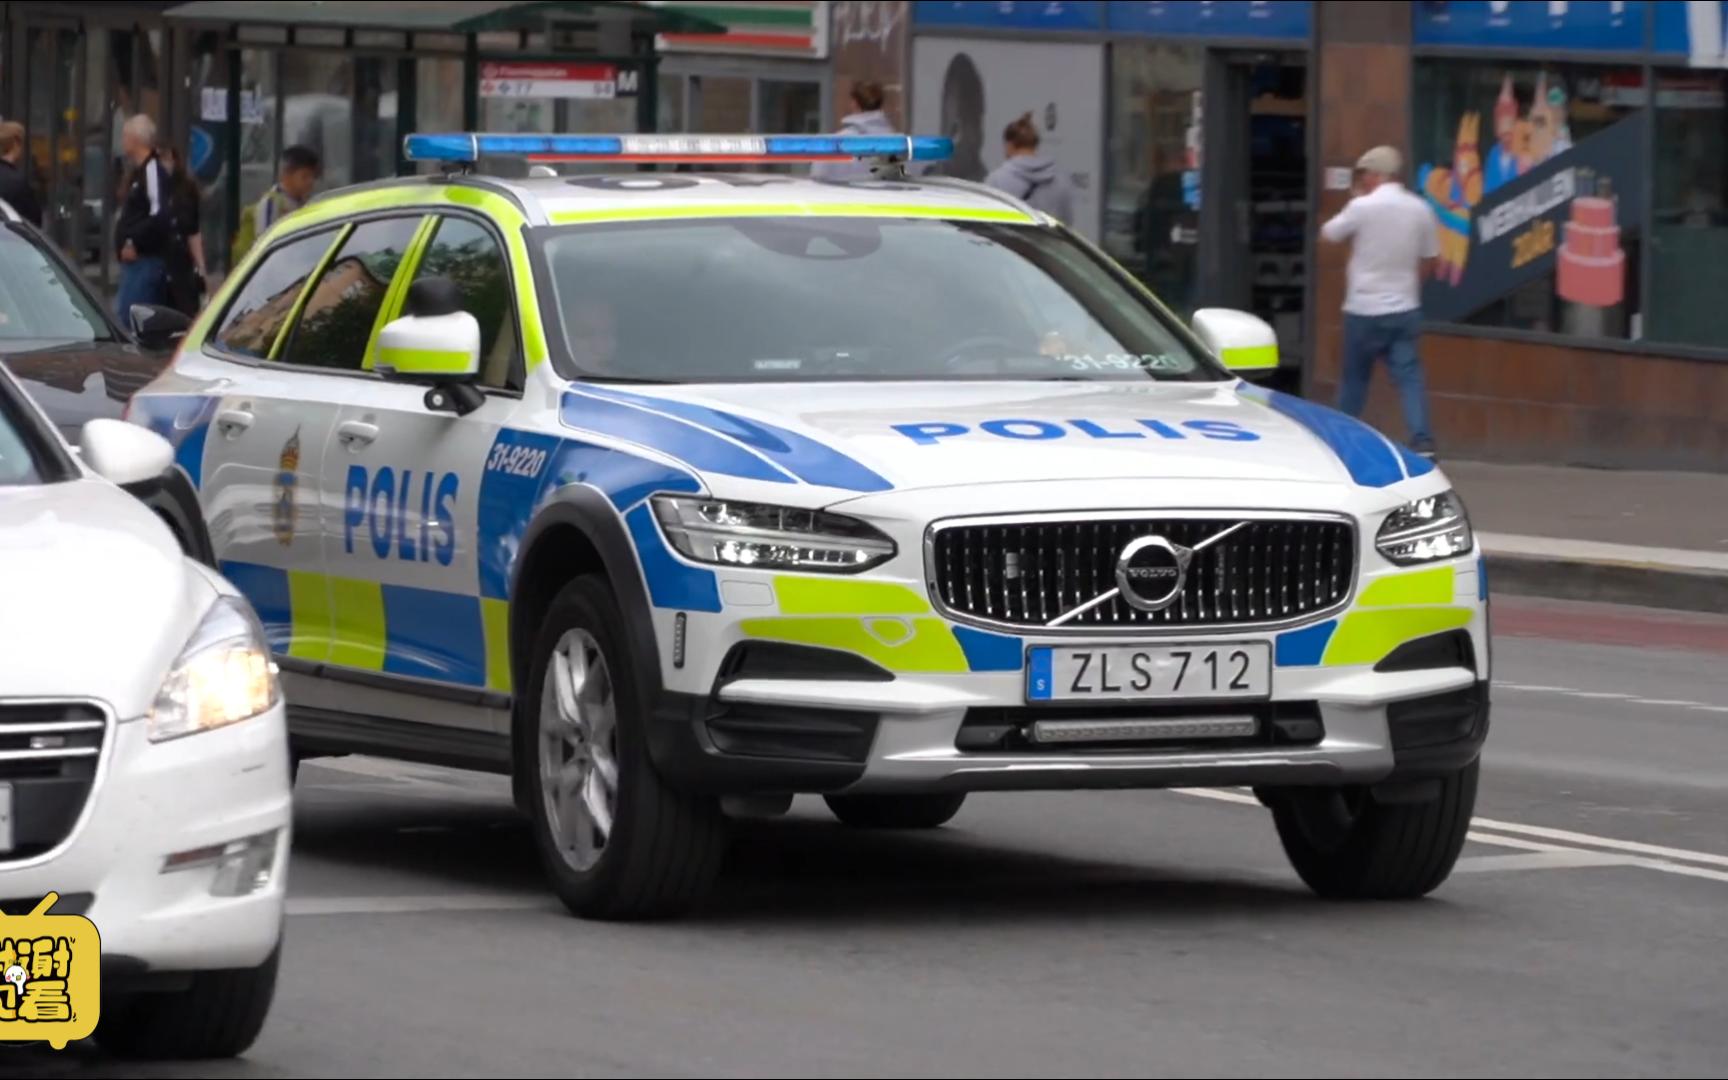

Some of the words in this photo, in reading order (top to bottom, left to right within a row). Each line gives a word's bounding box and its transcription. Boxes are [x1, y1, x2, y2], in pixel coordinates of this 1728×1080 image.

[617, 70, 638, 92] M
[891, 419, 1260, 445] POLIS
[488, 442, 546, 478] 31-9220
[343, 465, 459, 566] POLIS
[1129, 567, 1177, 578] VOLVO
[1070, 652, 1153, 693] ZLS
[1169, 650, 1251, 691] 712
[1037, 679, 1045, 691] S
